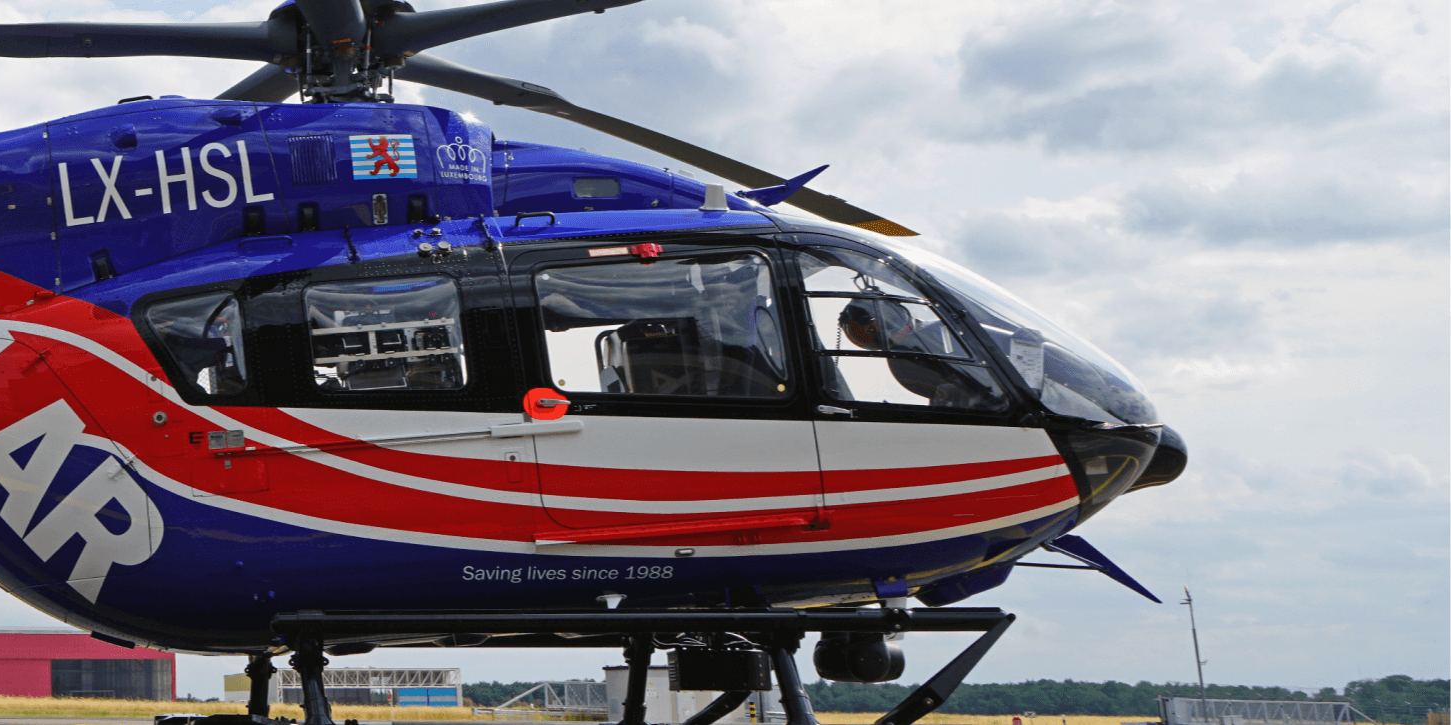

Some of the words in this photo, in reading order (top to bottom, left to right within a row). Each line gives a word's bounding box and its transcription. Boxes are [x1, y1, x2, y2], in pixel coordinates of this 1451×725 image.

[448, 163, 469, 171] MADE
[58, 139, 275, 227] LX-HSL
[440, 171, 488, 182] LUXEMBOURG
[462, 565, 523, 584] Saving
[527, 566, 567, 580] lives
[571, 566, 619, 580] since
[624, 565, 674, 580] 1988
